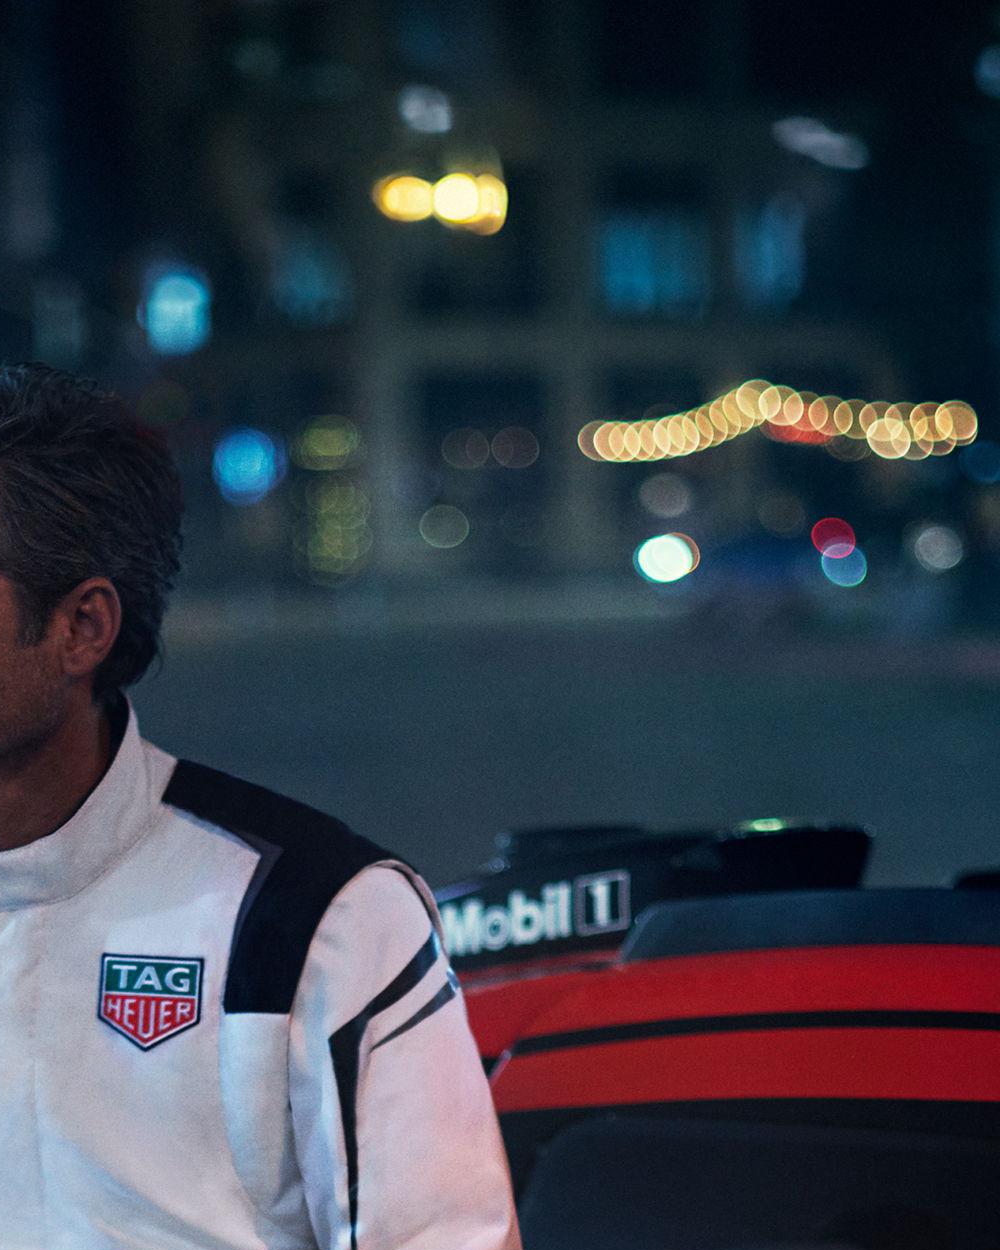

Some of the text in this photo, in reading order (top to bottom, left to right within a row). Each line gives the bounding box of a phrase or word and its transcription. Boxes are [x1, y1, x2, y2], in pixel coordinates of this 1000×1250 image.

[439, 877, 611, 956] Mobil 1
[112, 964, 191, 993] TAG
[106, 998, 192, 1039] HEUER
